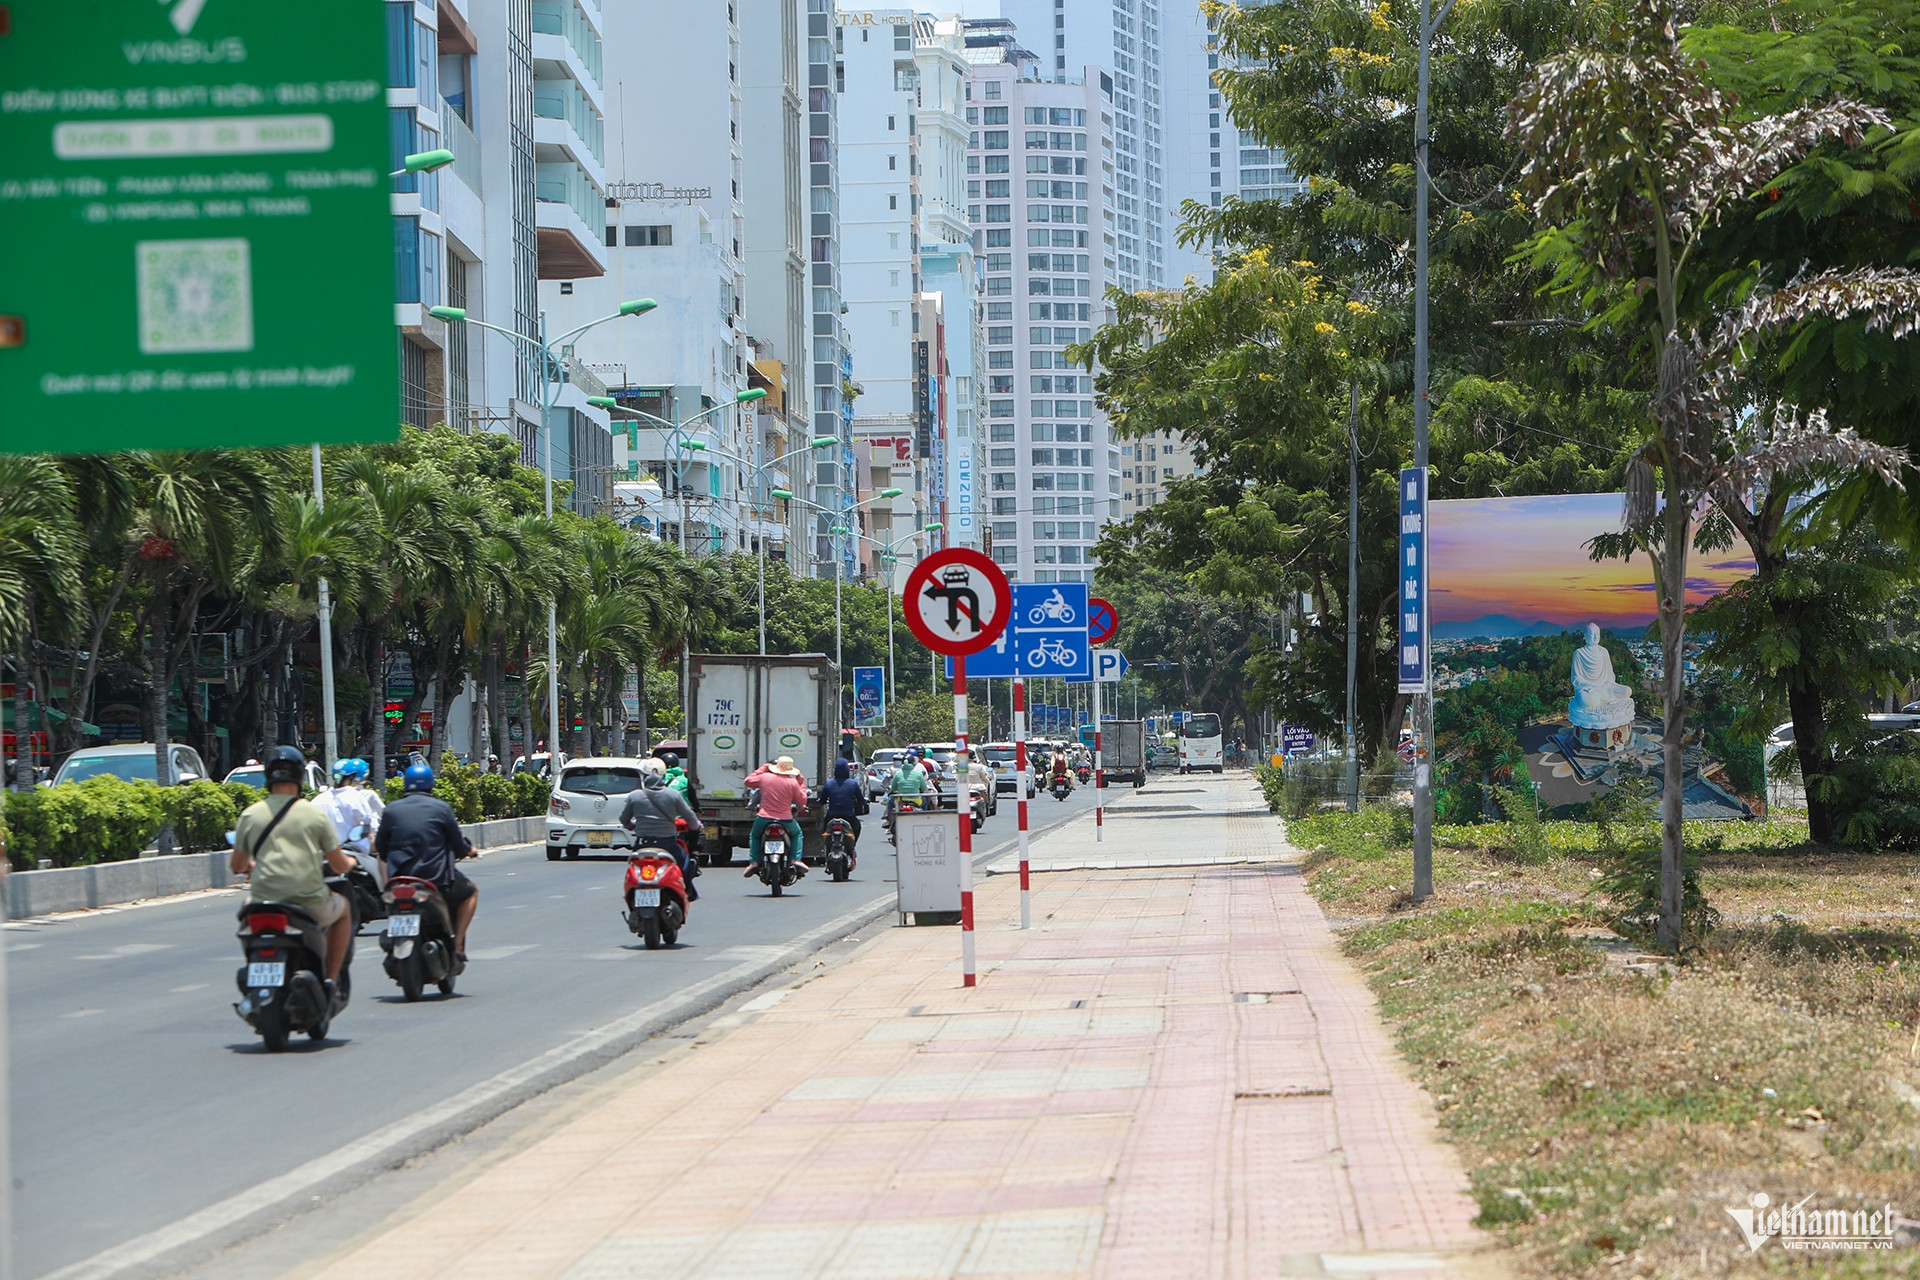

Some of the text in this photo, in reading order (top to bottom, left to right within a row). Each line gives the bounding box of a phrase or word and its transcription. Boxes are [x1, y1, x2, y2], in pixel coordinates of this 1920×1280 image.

[881, 16, 908, 24] HOTEL
[121, 36, 247, 65] VINBUS
[323, 79, 381, 104] STOP
[919, 347, 929, 383] EURO
[920, 389, 929, 424] STAR
[744, 414, 755, 486] REGALIA
[1402, 510, 1421, 534] KHÔNG
[1405, 576, 1417, 599] RÁC
[1405, 606, 1418, 632] THẢI
[1099, 655, 1117, 677] P
[1403, 644, 1420, 669] NHỰA
[715, 699, 734, 711] 79C
[1184, 713, 1190, 721] P
[708, 713, 741, 726] 177.47
